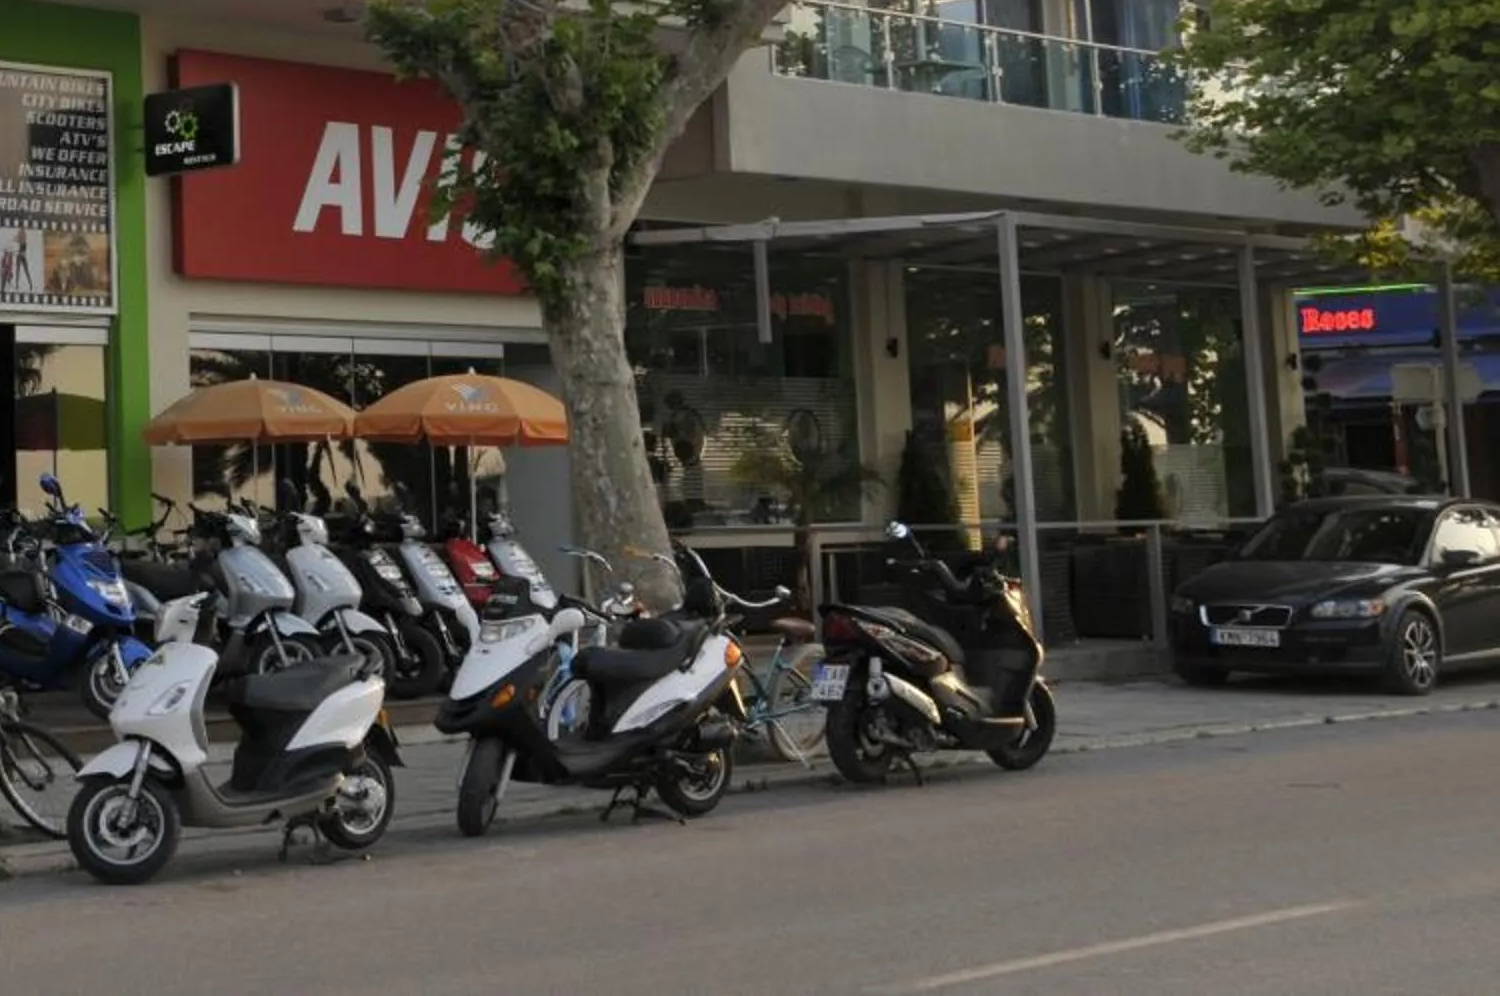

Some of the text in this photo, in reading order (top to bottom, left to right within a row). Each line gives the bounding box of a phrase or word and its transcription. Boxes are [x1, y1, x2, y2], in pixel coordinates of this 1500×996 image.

[58, 78, 106, 95] BIKES
[21, 93, 106, 113] CITY BIKES
[25, 111, 107, 131] SCOOTERS
[59, 131, 107, 148] ATV'S
[154, 140, 196, 156] ESCAPE
[31, 147, 107, 165] WE OFFER
[18, 162, 108, 182] INSURANCE
[18, 180, 108, 200] INSURANCE
[44, 199, 108, 217] SERVICE
